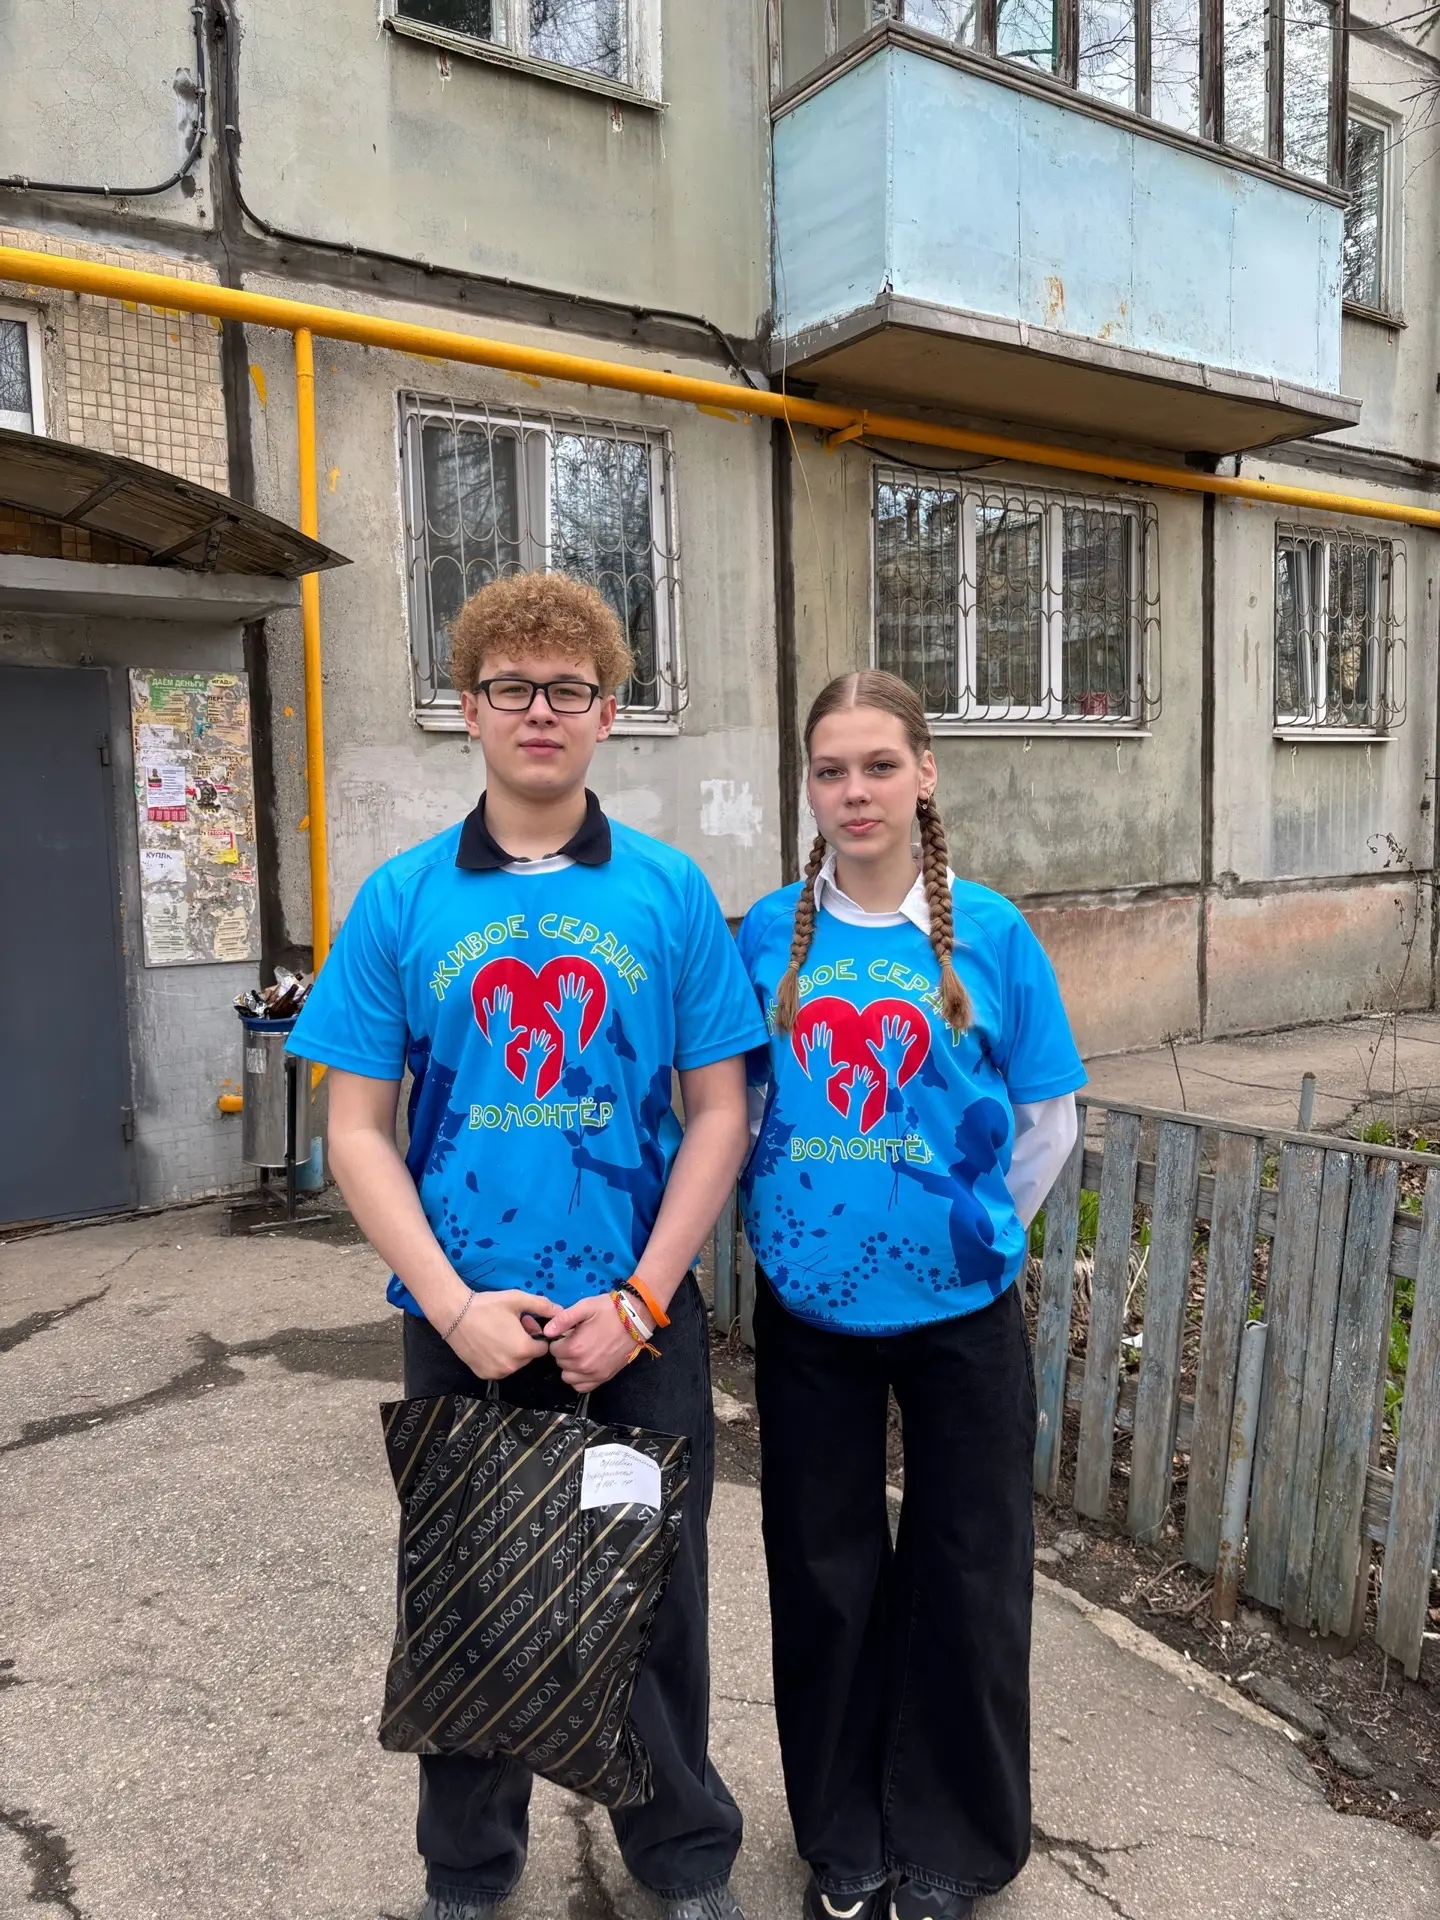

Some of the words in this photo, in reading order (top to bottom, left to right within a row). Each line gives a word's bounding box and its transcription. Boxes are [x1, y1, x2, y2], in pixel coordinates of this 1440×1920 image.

[152, 677, 174, 686] ДАЁМ
[175, 679, 204, 688] ДЕНЬГИ
[428, 914, 528, 1002] ЖИВОЕ
[538, 914, 648, 994] СЕРДЦЕ
[468, 1098, 614, 1132] ВОЛОНТЁР
[393, 1399, 427, 1450] STONES
[470, 1436, 518, 1492] STONES
[519, 1423, 534, 1437] &
[408, 1508, 455, 1564] SAMSON
[413, 1560, 456, 1613] STONES
[458, 1546, 471, 1560] &
[470, 1483, 525, 1545] SAMSON
[478, 1536, 528, 1594] STONES
[530, 1522, 544, 1538] &
[552, 1513, 596, 1569] STONES
[412, 1608, 462, 1668] SAMSON
[502, 1626, 552, 1682] STONES
[554, 1610, 569, 1626] &
[568, 1544, 620, 1608] SAMSON
[576, 1597, 624, 1659] STONES
[626, 1582, 640, 1595] &
[422, 1662, 466, 1712] STONES
[466, 1648, 480, 1664] &
[480, 1586, 535, 1648] SAMSON
[444, 1694, 490, 1740] SAMSON
[497, 1732, 512, 1744] &
[508, 1676, 562, 1733] SAMSON
[525, 1728, 569, 1764] STONES
[568, 1715, 584, 1729] &
[607, 1775, 620, 1787] &
